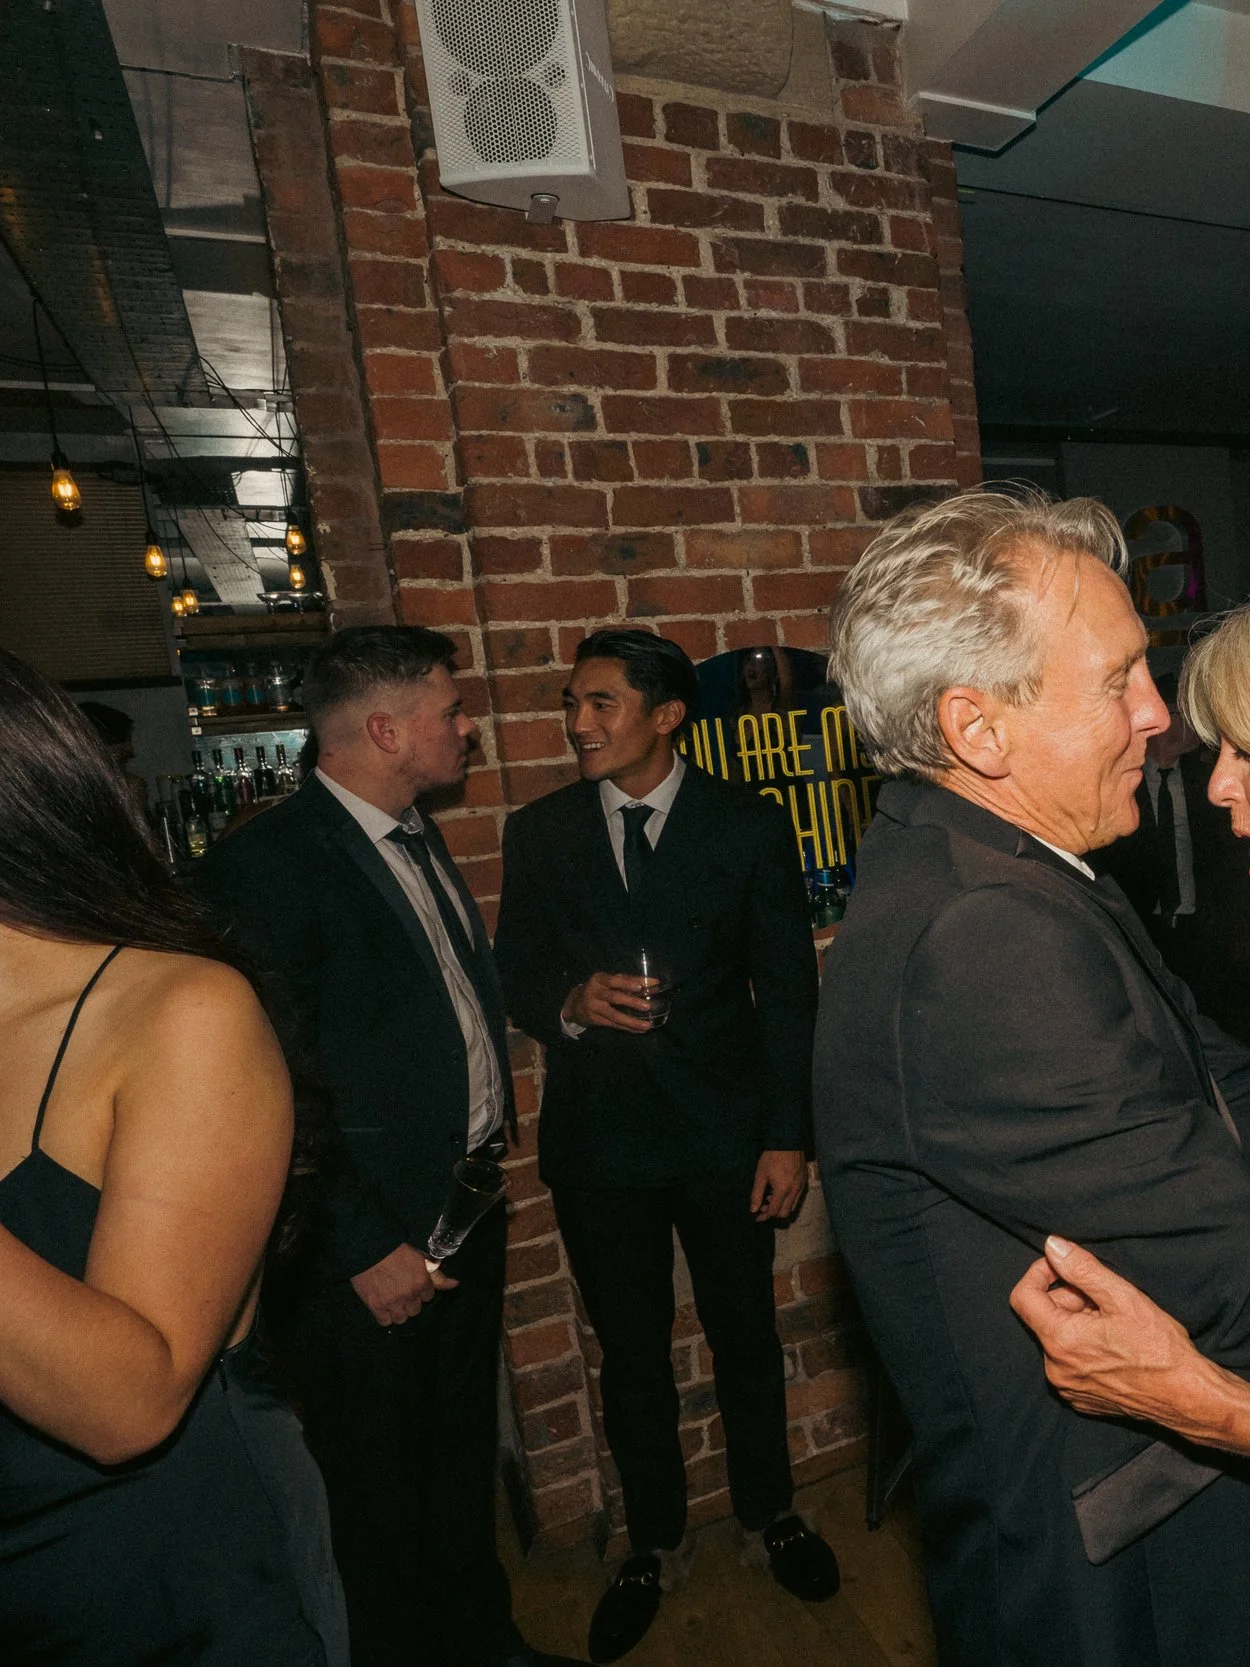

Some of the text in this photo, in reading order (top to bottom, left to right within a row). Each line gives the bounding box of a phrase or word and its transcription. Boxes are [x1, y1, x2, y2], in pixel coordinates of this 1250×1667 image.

[737, 709, 814, 782] ARE
[820, 705, 875, 772] M
[759, 774, 884, 872] HIN
